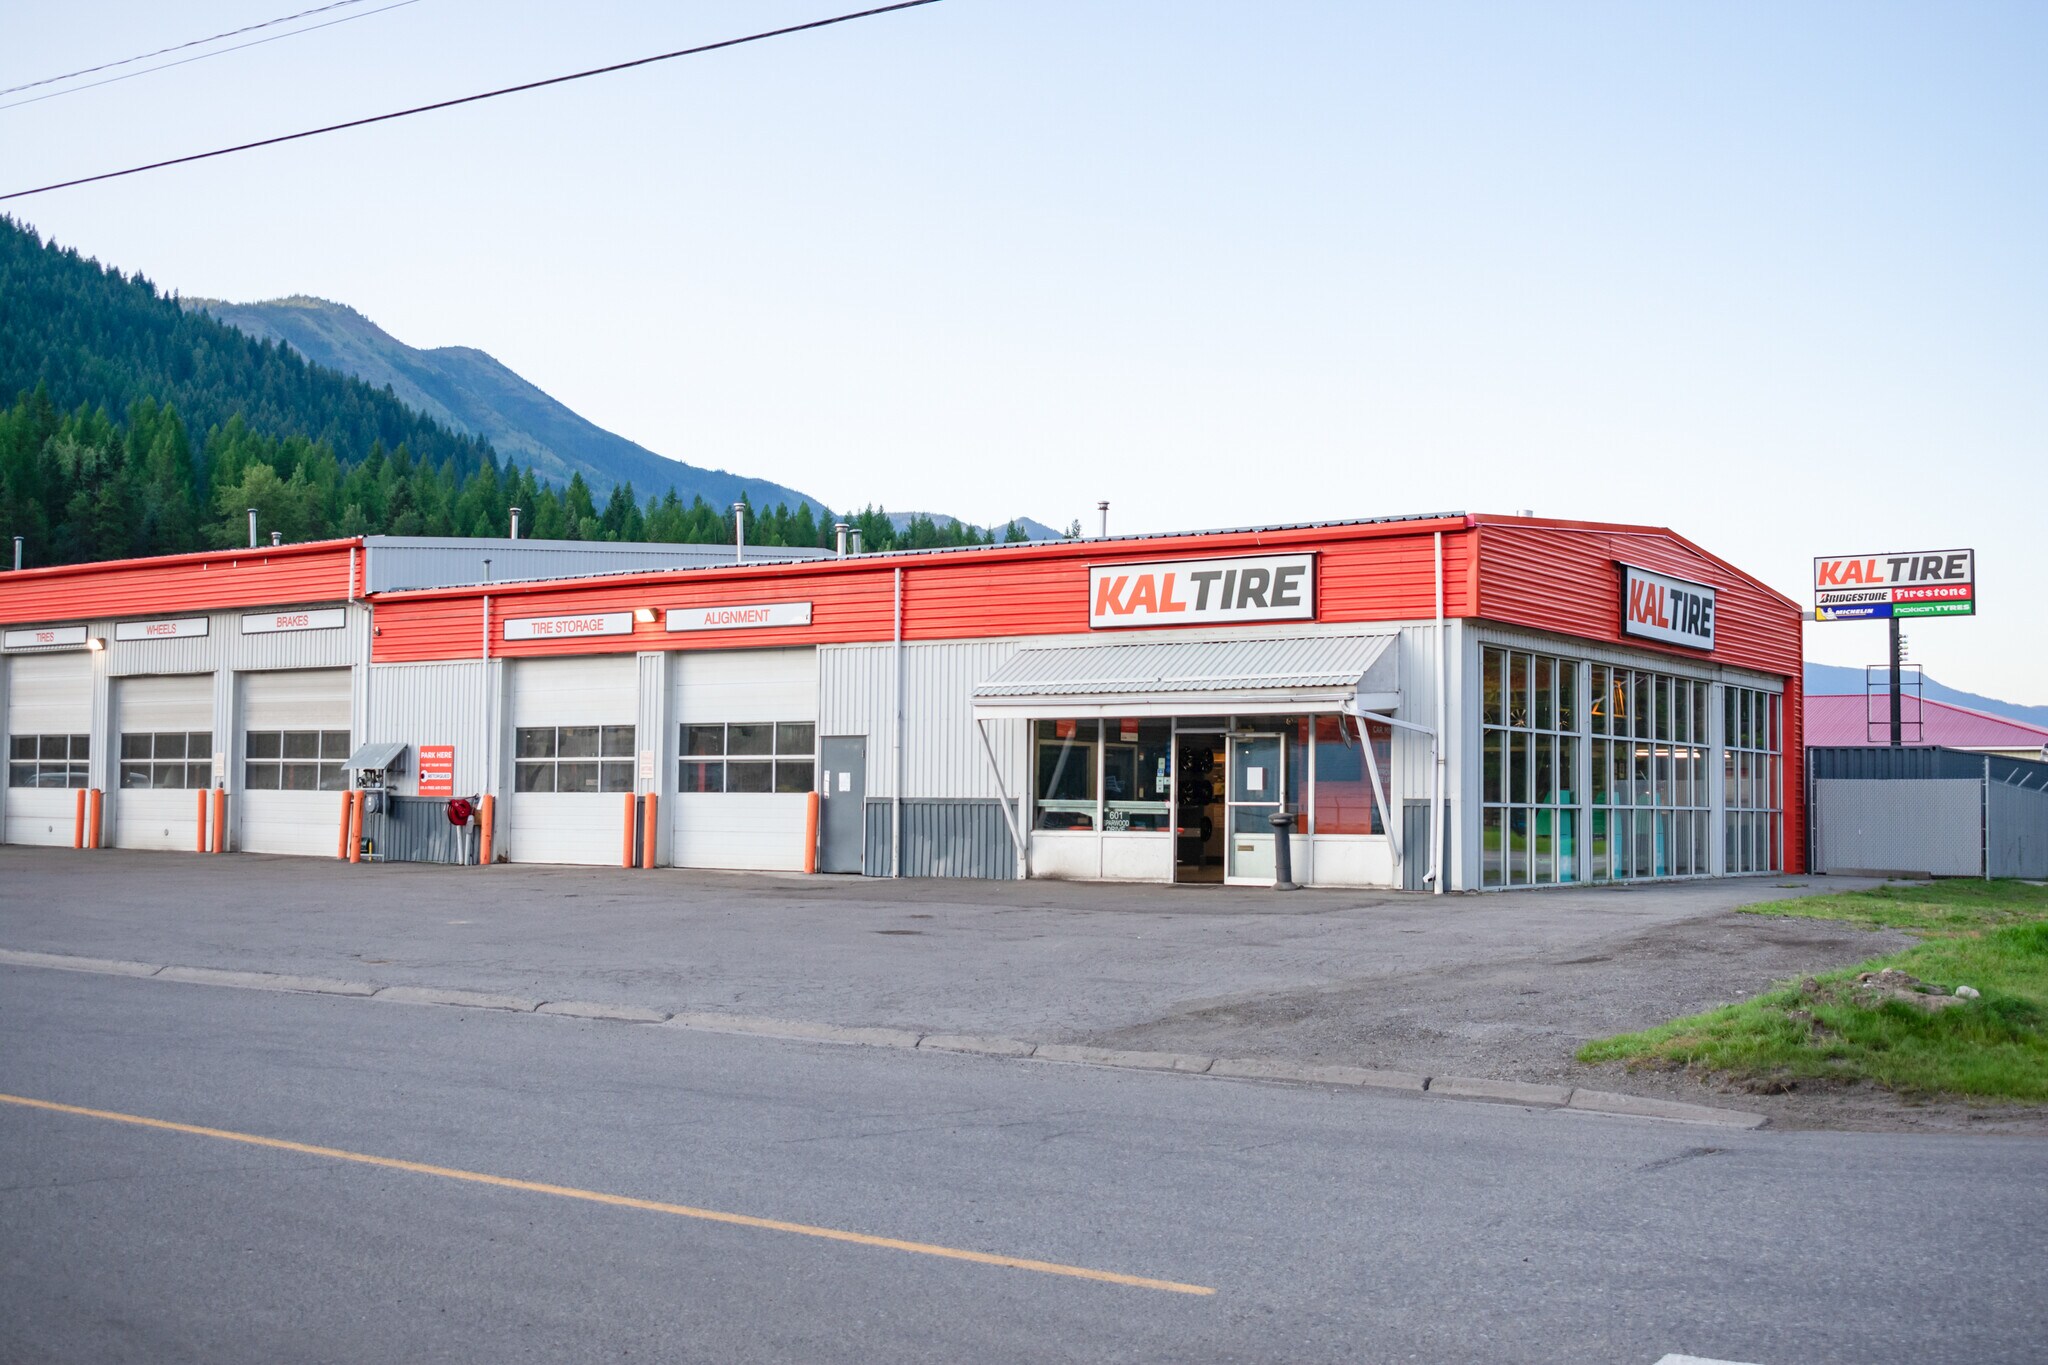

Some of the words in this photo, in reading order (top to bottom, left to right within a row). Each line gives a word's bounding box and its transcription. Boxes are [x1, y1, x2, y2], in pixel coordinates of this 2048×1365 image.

[1817, 559, 1884, 586] KAL
[1886, 554, 1968, 582] TIRE
[1095, 572, 1187, 616] KAL
[1190, 565, 1306, 611] TIRE
[1894, 588, 1967, 600] Firestone
[1820, 592, 1888, 603] BRIDGESTONE
[1628, 578, 1669, 629] KAL
[1670, 588, 1713, 638] TIRE
[276, 616, 309, 628] BRAKES
[704, 609, 771, 625] ALIGNMENT
[146, 623, 177, 635] WHEELS
[531, 622, 553, 635] TIRE
[555, 619, 604, 633] STORAGE
[35, 632, 55, 642] TIRES
[1109, 811, 1123, 819] 601
